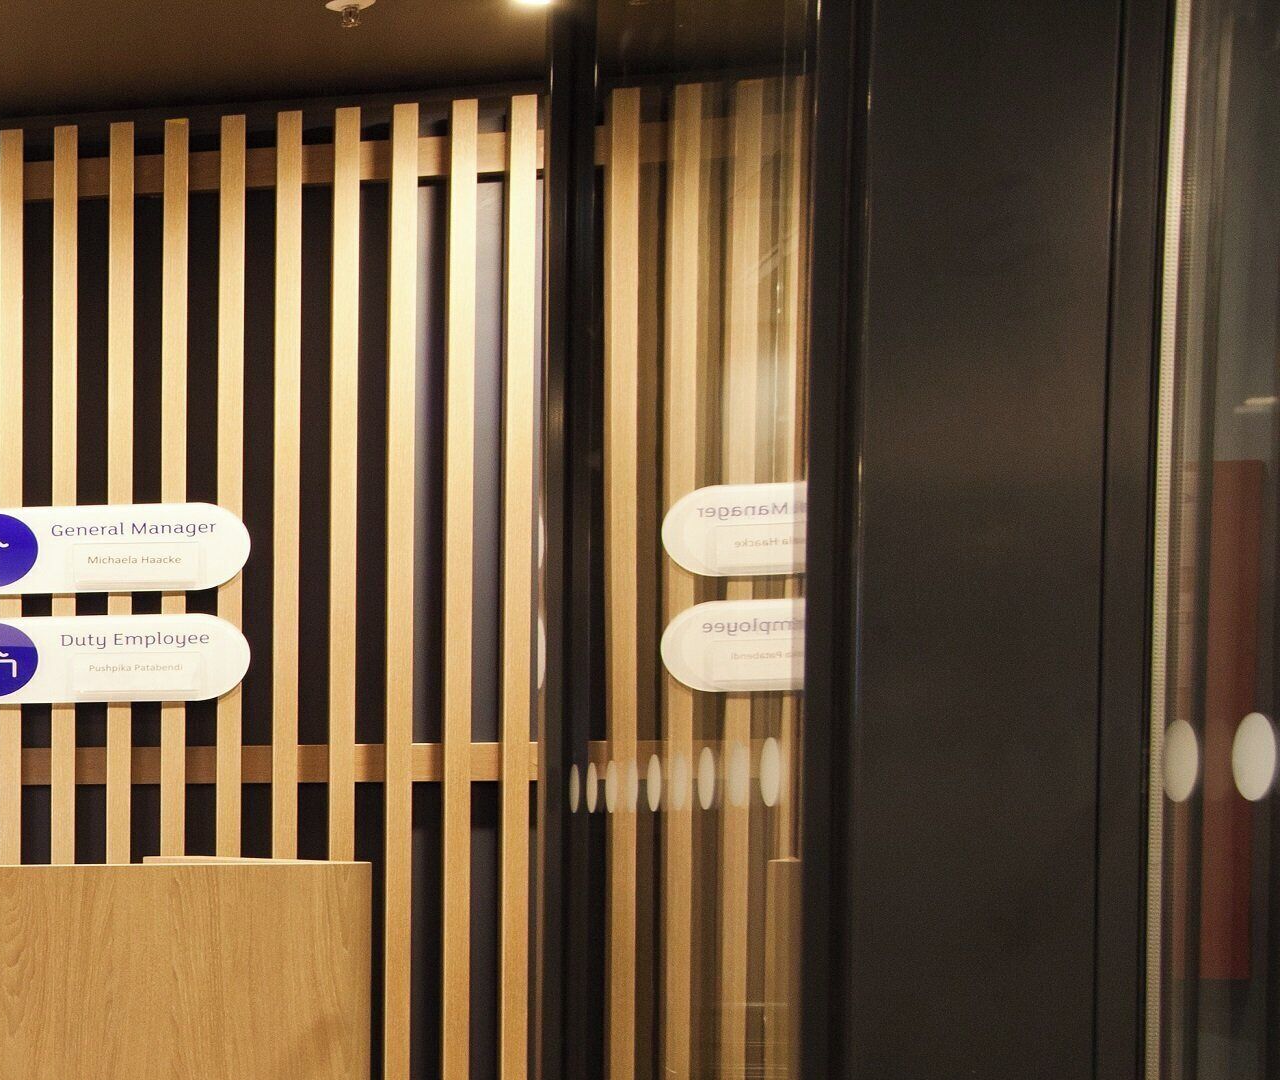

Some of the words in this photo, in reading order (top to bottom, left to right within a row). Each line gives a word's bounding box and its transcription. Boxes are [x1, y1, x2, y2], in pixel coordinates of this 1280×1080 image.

[51, 522, 124, 537] General
[131, 521, 217, 538] Manager
[87, 556, 138, 565] Michaela
[141, 556, 182, 565] Haacke
[60, 634, 107, 650] Duty
[113, 631, 210, 649] Employee
